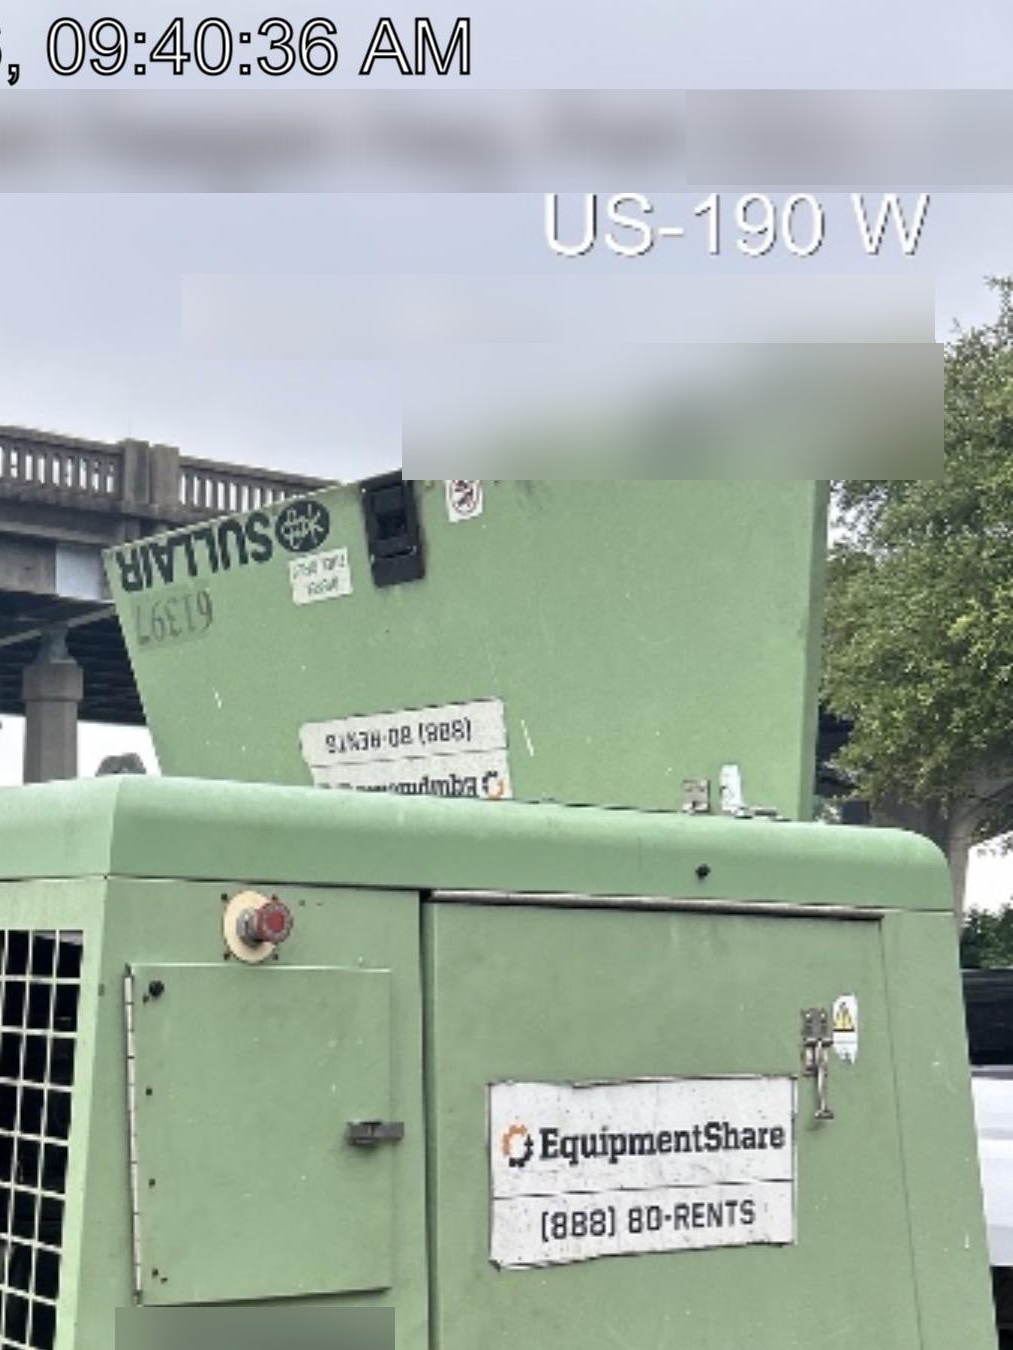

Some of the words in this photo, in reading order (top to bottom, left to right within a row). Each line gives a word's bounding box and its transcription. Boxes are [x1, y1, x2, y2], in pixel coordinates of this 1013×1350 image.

[115, 511, 273, 592] SULLAIR
[135, 588, 213, 645] 61397
[539, 1121, 786, 1166] EquipmentShare
[541, 1206, 616, 1242] (888)
[628, 1199, 756, 1234] 80-RENTS
